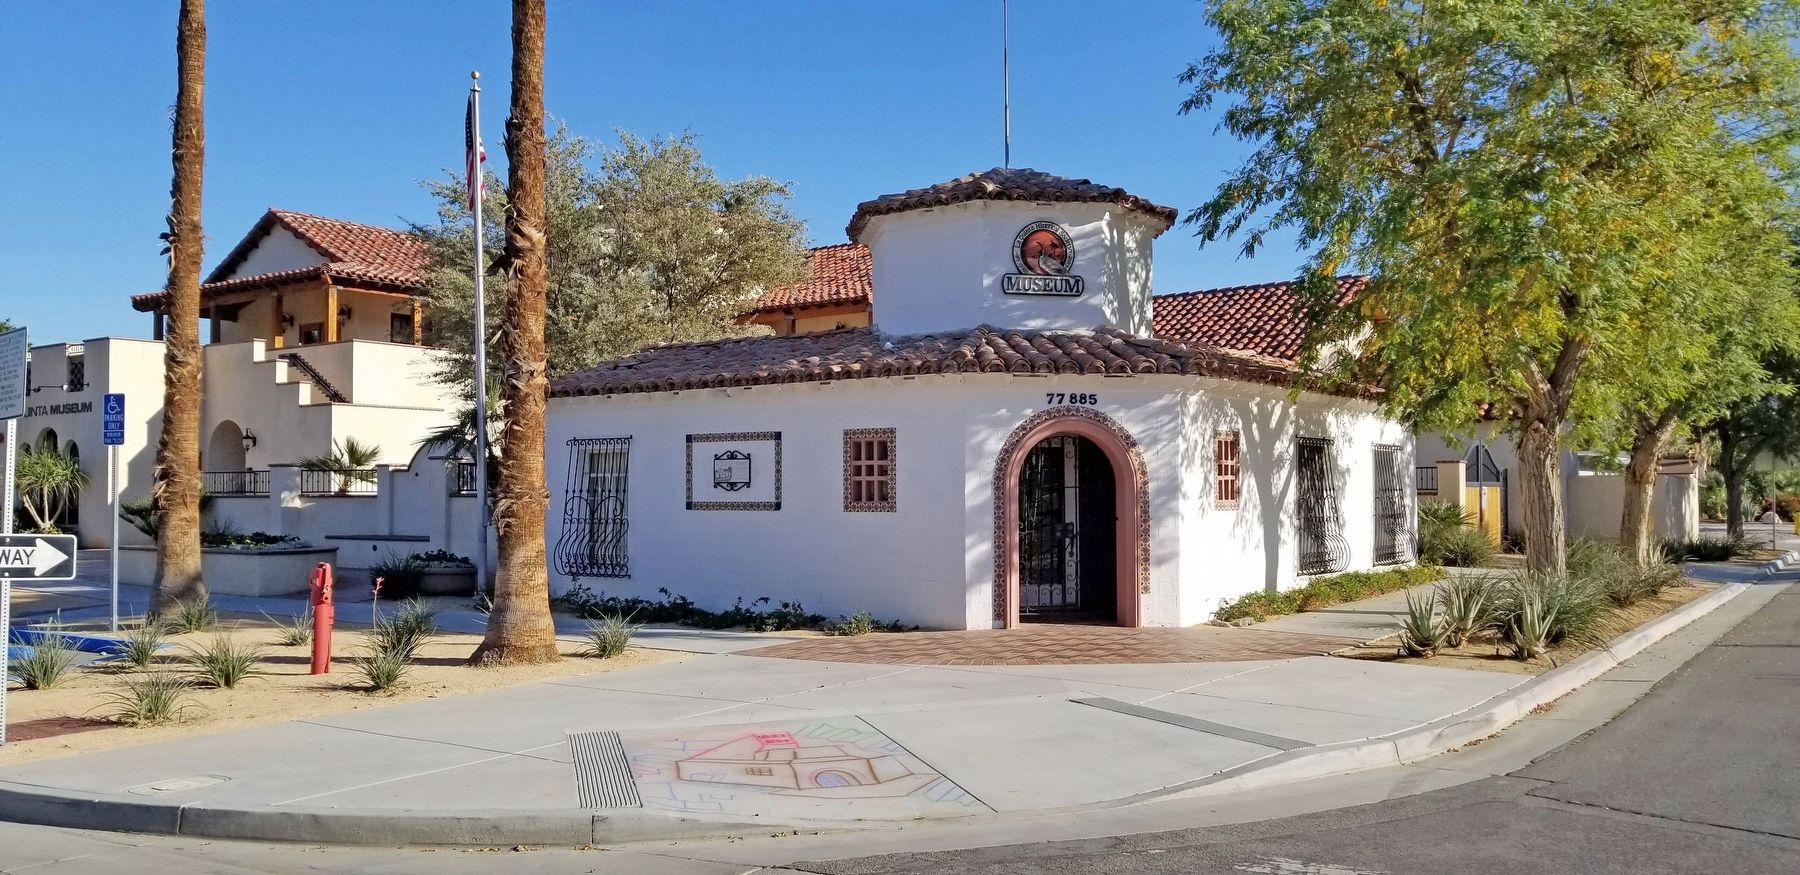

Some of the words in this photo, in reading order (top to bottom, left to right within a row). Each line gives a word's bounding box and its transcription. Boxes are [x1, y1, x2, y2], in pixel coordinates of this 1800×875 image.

[1006, 276, 1080, 293] MUSEUM
[50, 402, 92, 415] MUSEUM
[104, 413, 124, 421] PARKING
[108, 422, 120, 430] ONLY
